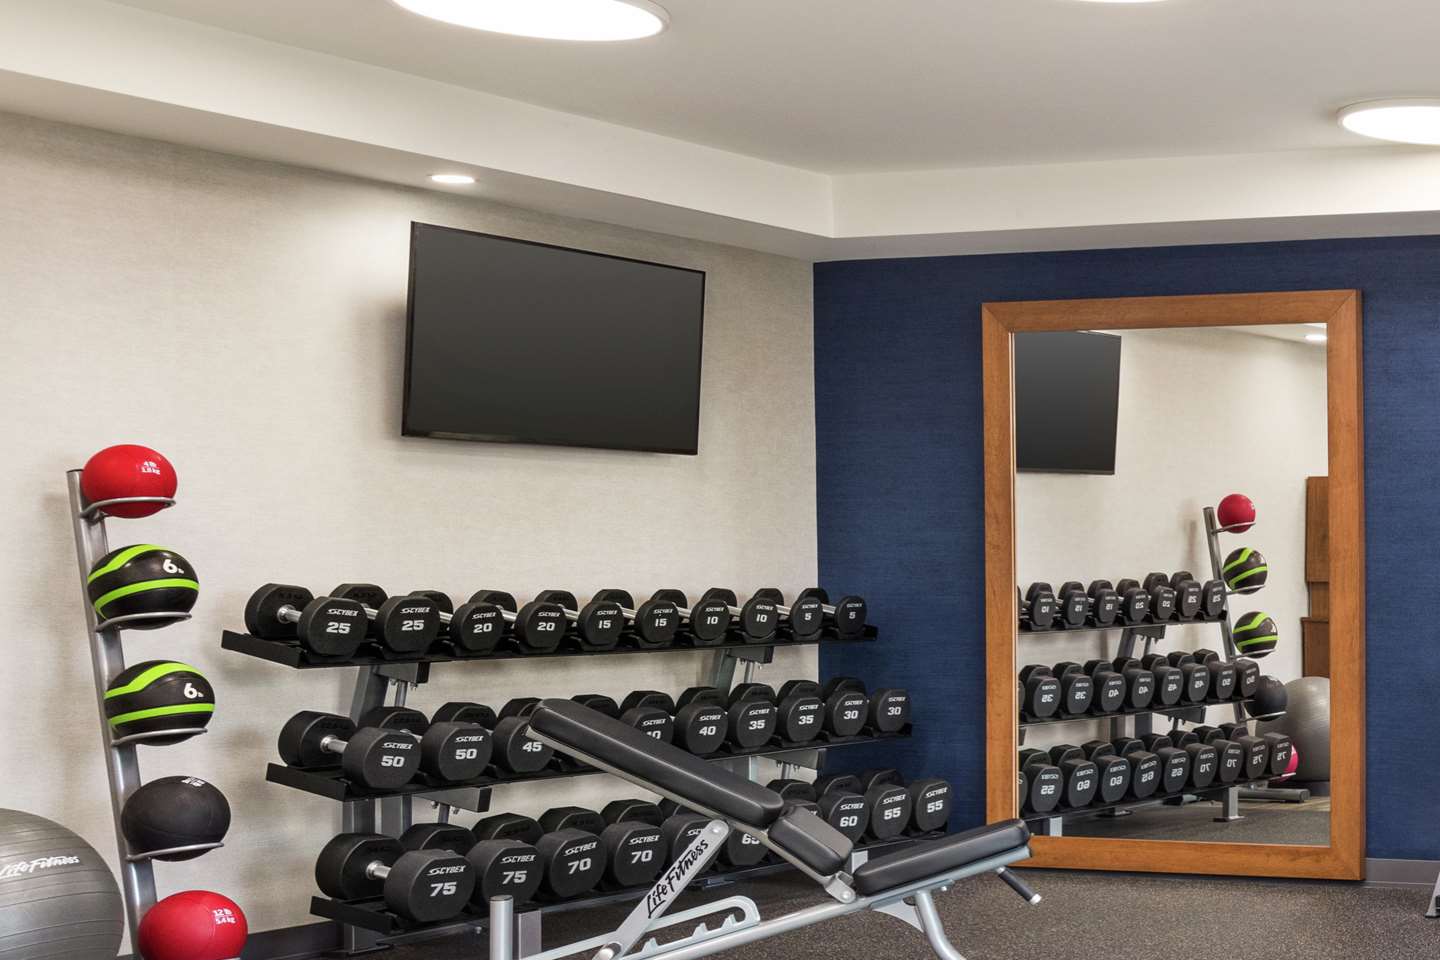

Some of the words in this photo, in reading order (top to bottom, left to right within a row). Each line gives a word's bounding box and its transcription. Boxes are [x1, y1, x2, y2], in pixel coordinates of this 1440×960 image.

[163, 559, 178, 574] 6
[756, 614, 768, 622] 10
[805, 613, 812, 621] 5
[849, 612, 856, 620] 5
[326, 622, 352, 634] 25
[401, 620, 424, 631] 25
[473, 623, 492, 634] 20
[537, 622, 555, 632] 20
[598, 620, 612, 629] 15
[655, 619, 668, 627] 15
[184, 682, 198, 699] 6
[843, 711, 858, 720] 30
[888, 707, 902, 716] 30
[749, 720, 766, 730] 35
[798, 715, 814, 725] 35
[699, 726, 717, 736] 40
[522, 742, 542, 752] 45
[455, 749, 478, 760] 50
[381, 756, 404, 768] 50
[927, 800, 944, 813] 55
[884, 807, 902, 820] 55
[840, 816, 858, 828] 60
[631, 850, 654, 864] 70
[567, 858, 592, 874] 70
[502, 871, 528, 884] 75
[430, 882, 458, 897] 75
